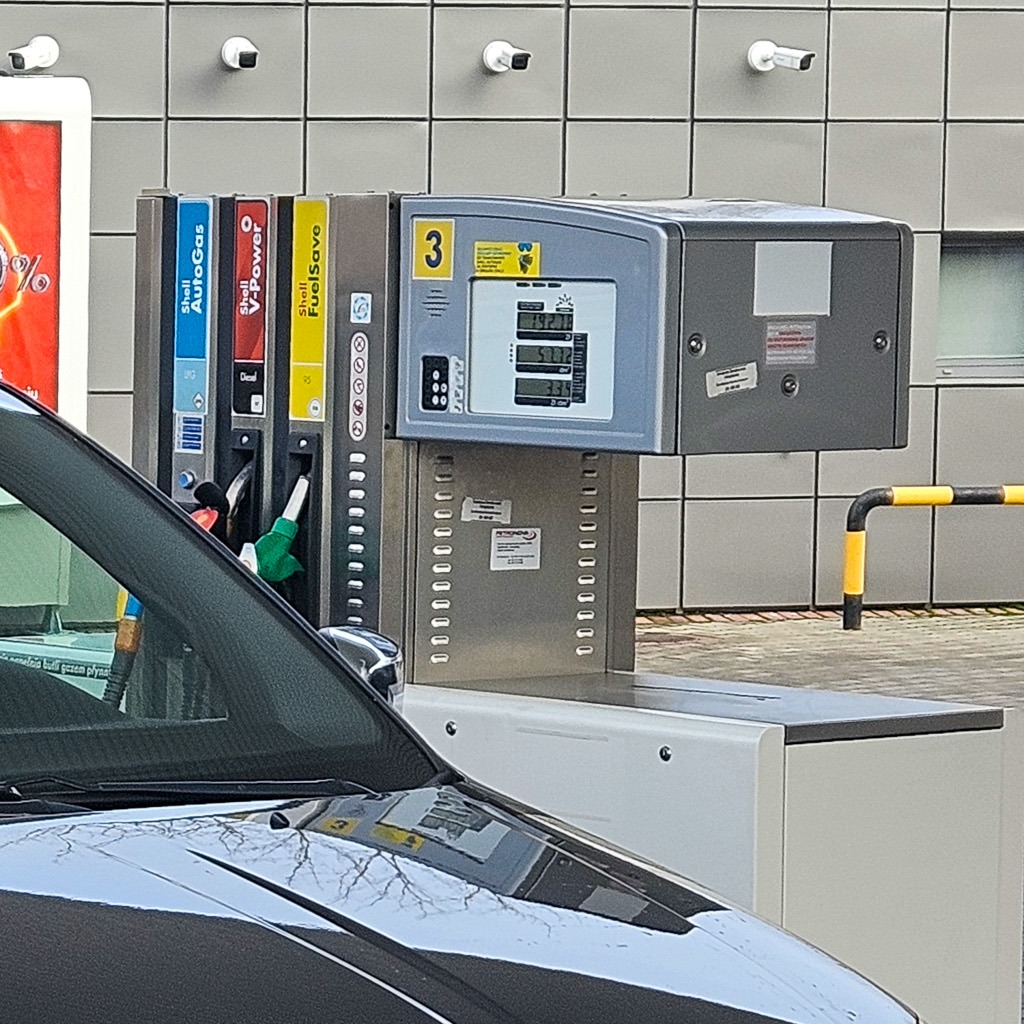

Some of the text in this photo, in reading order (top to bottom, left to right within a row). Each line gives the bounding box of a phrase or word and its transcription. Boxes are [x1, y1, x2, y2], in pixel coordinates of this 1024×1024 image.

[425, 230, 442, 268] 3
[191, 224, 204, 314] AutoGas
[249, 222, 262, 315] V-Power
[308, 225, 321, 317] FuelSave
[181, 279, 190, 314] Shell
[240, 281, 249, 315] Shell
[299, 282, 308, 317] Shell
[303, 376, 312, 385] 95
[61, 664, 85, 674] gazem
